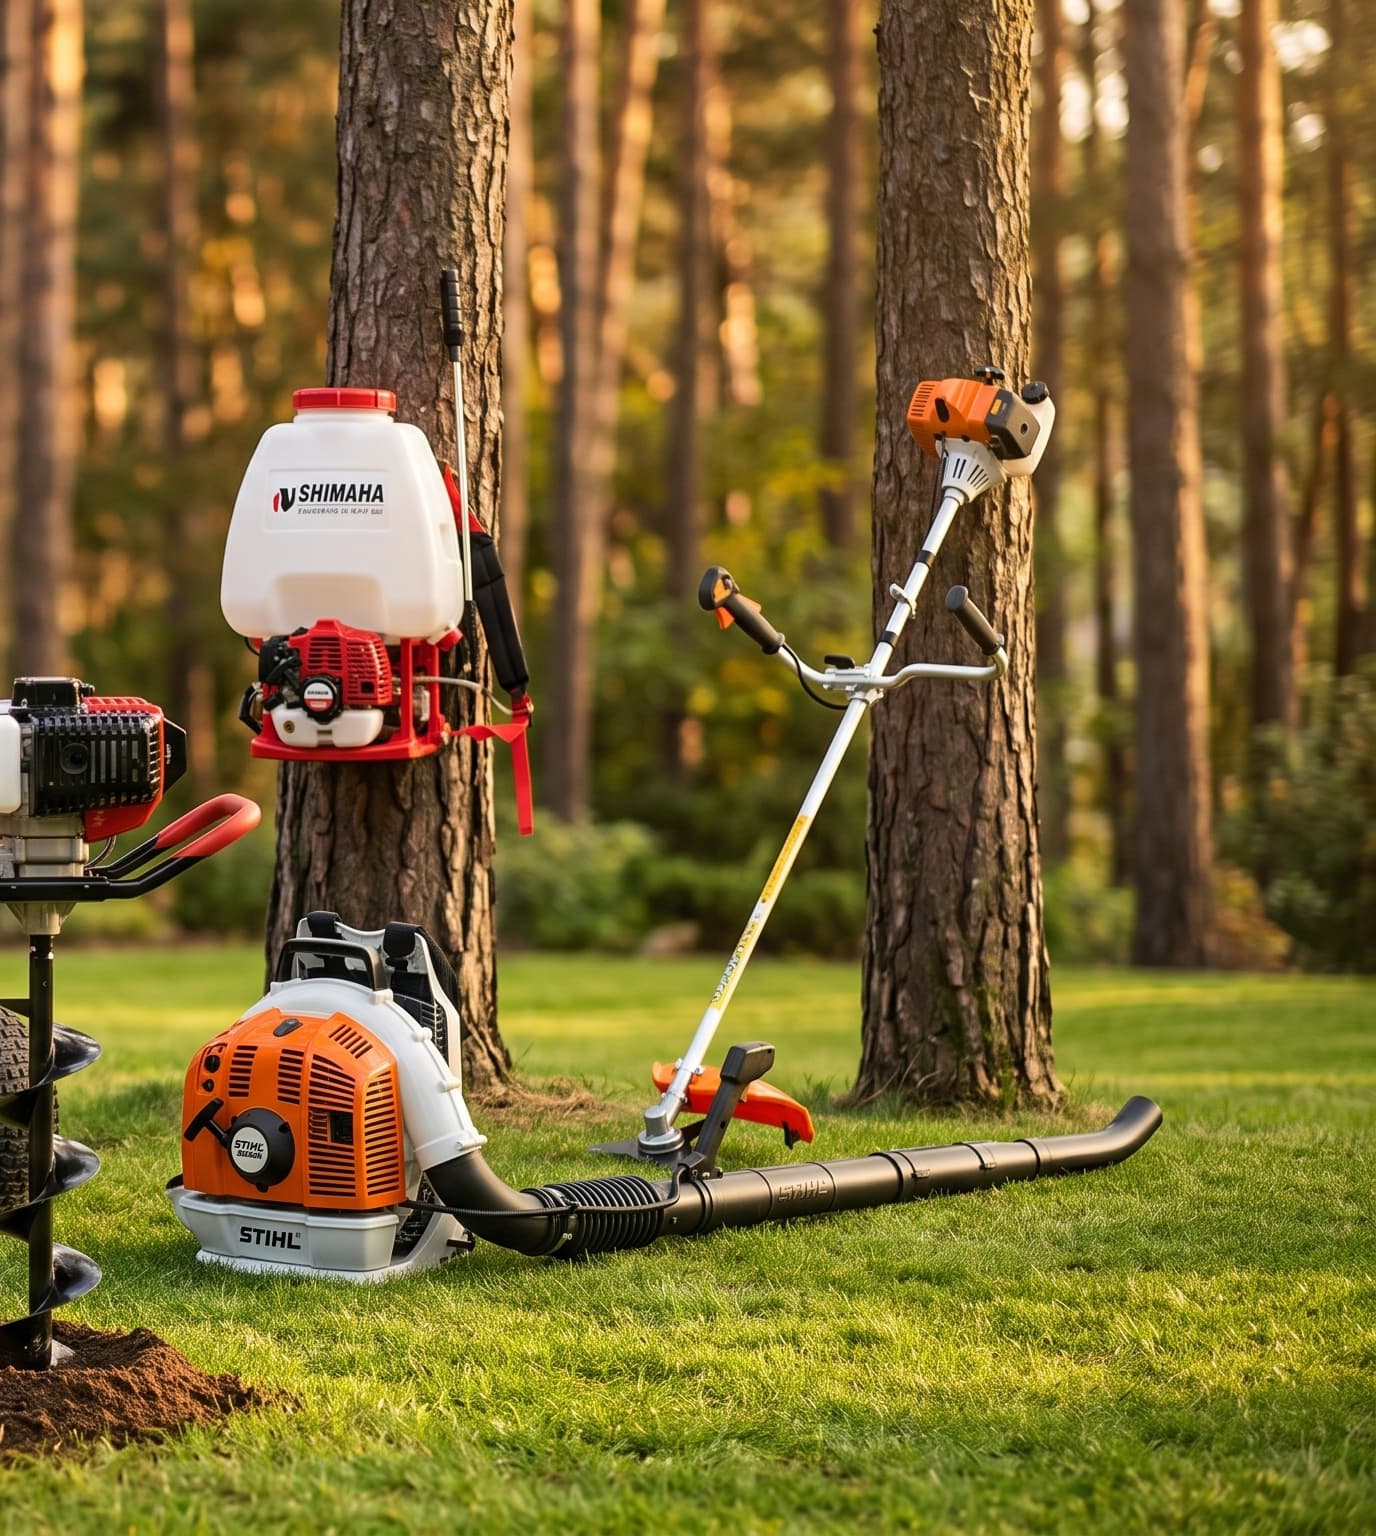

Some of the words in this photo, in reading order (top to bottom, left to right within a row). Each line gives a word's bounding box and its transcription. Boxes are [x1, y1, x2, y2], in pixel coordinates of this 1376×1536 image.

[298, 483, 384, 503] SHIMAHA
[234, 1140, 264, 1152] STIHL
[239, 1226, 301, 1250] STIHL
